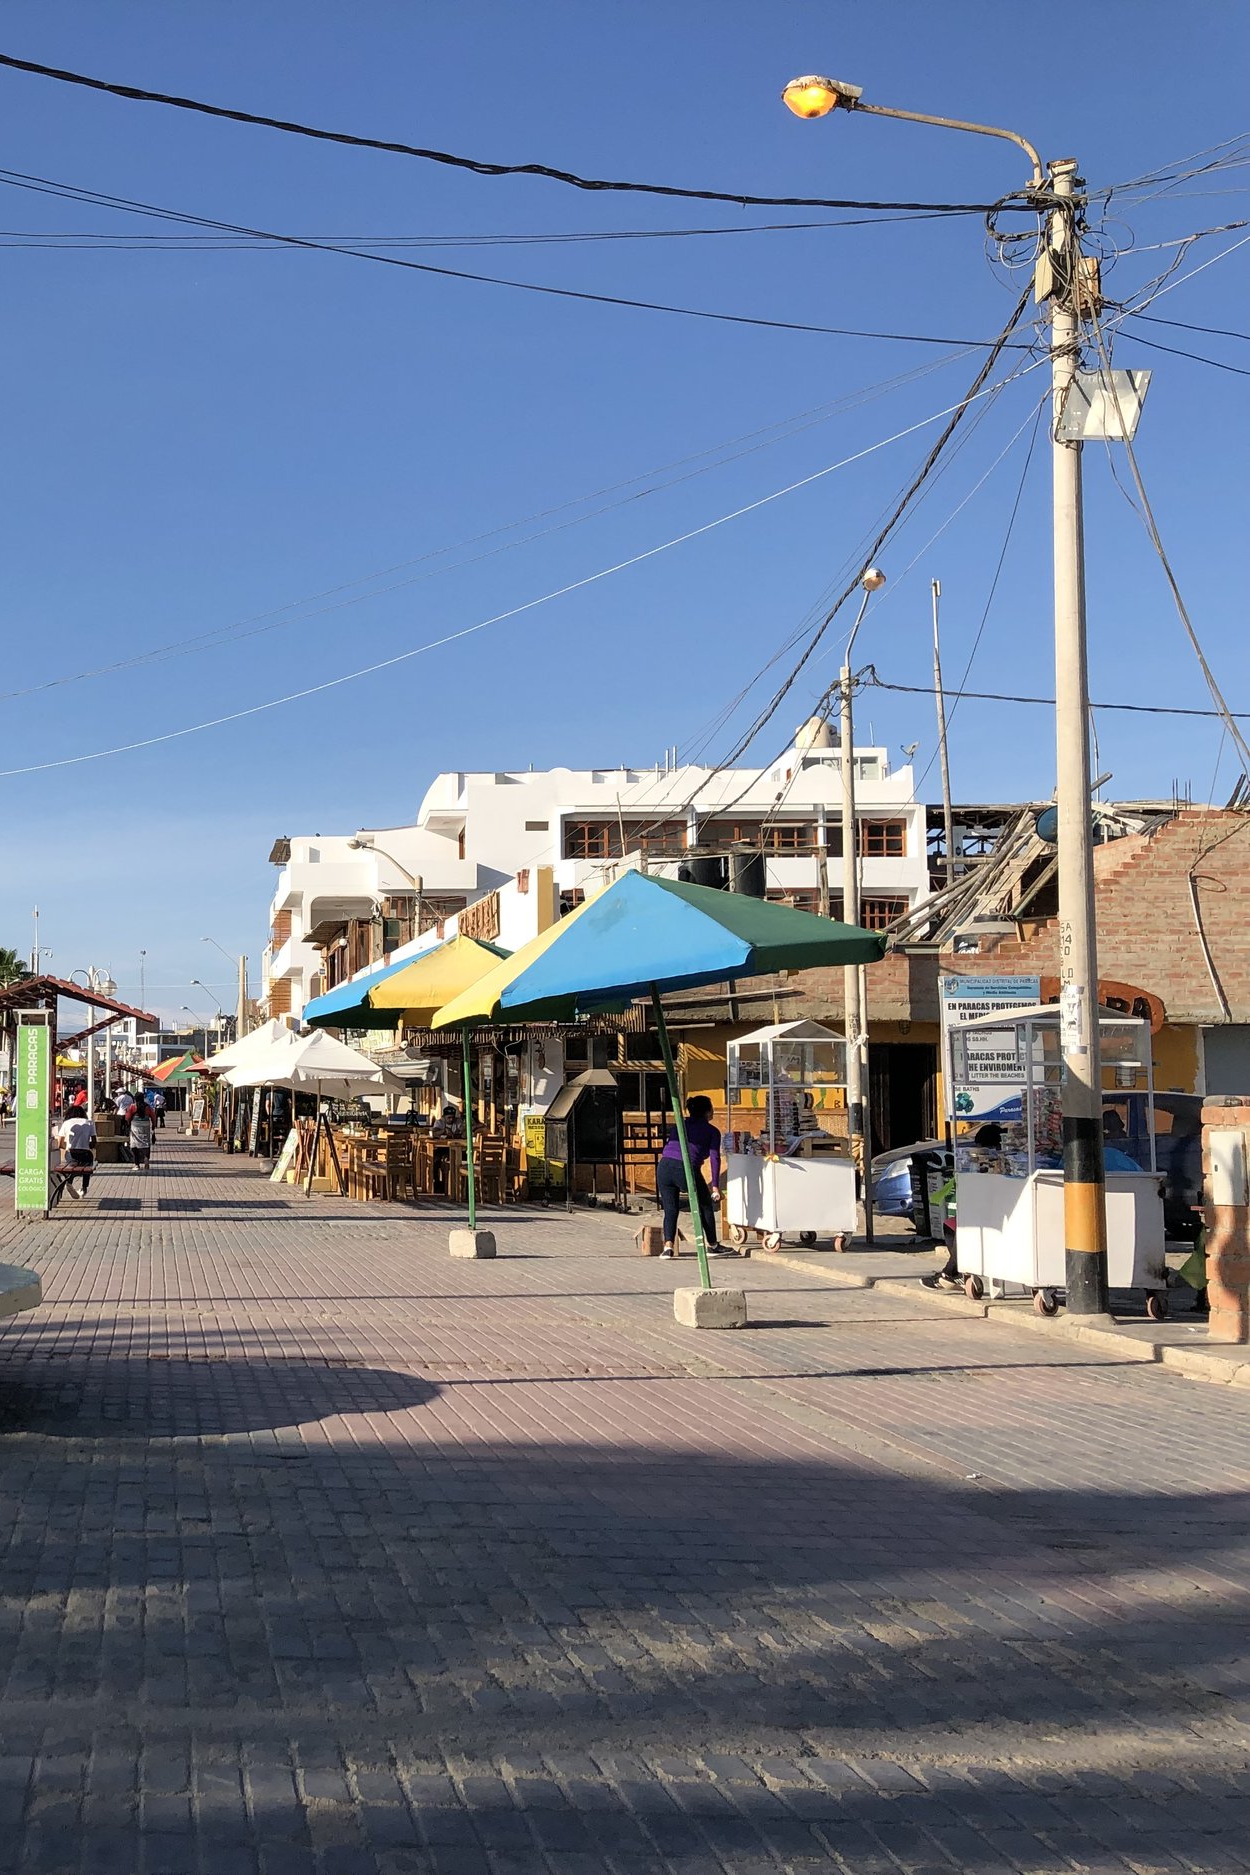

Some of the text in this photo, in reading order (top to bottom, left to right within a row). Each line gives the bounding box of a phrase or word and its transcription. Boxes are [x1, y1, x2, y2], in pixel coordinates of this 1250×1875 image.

[958, 1002, 990, 1010] PARACAS
[27, 1028, 39, 1085] PARACAS
[961, 1052, 995, 1061] ARACAS
[979, 1063, 1026, 1072] ENVIROMENT
[18, 1167, 44, 1175] CARGA
[18, 1177, 44, 1185] GRATIS
